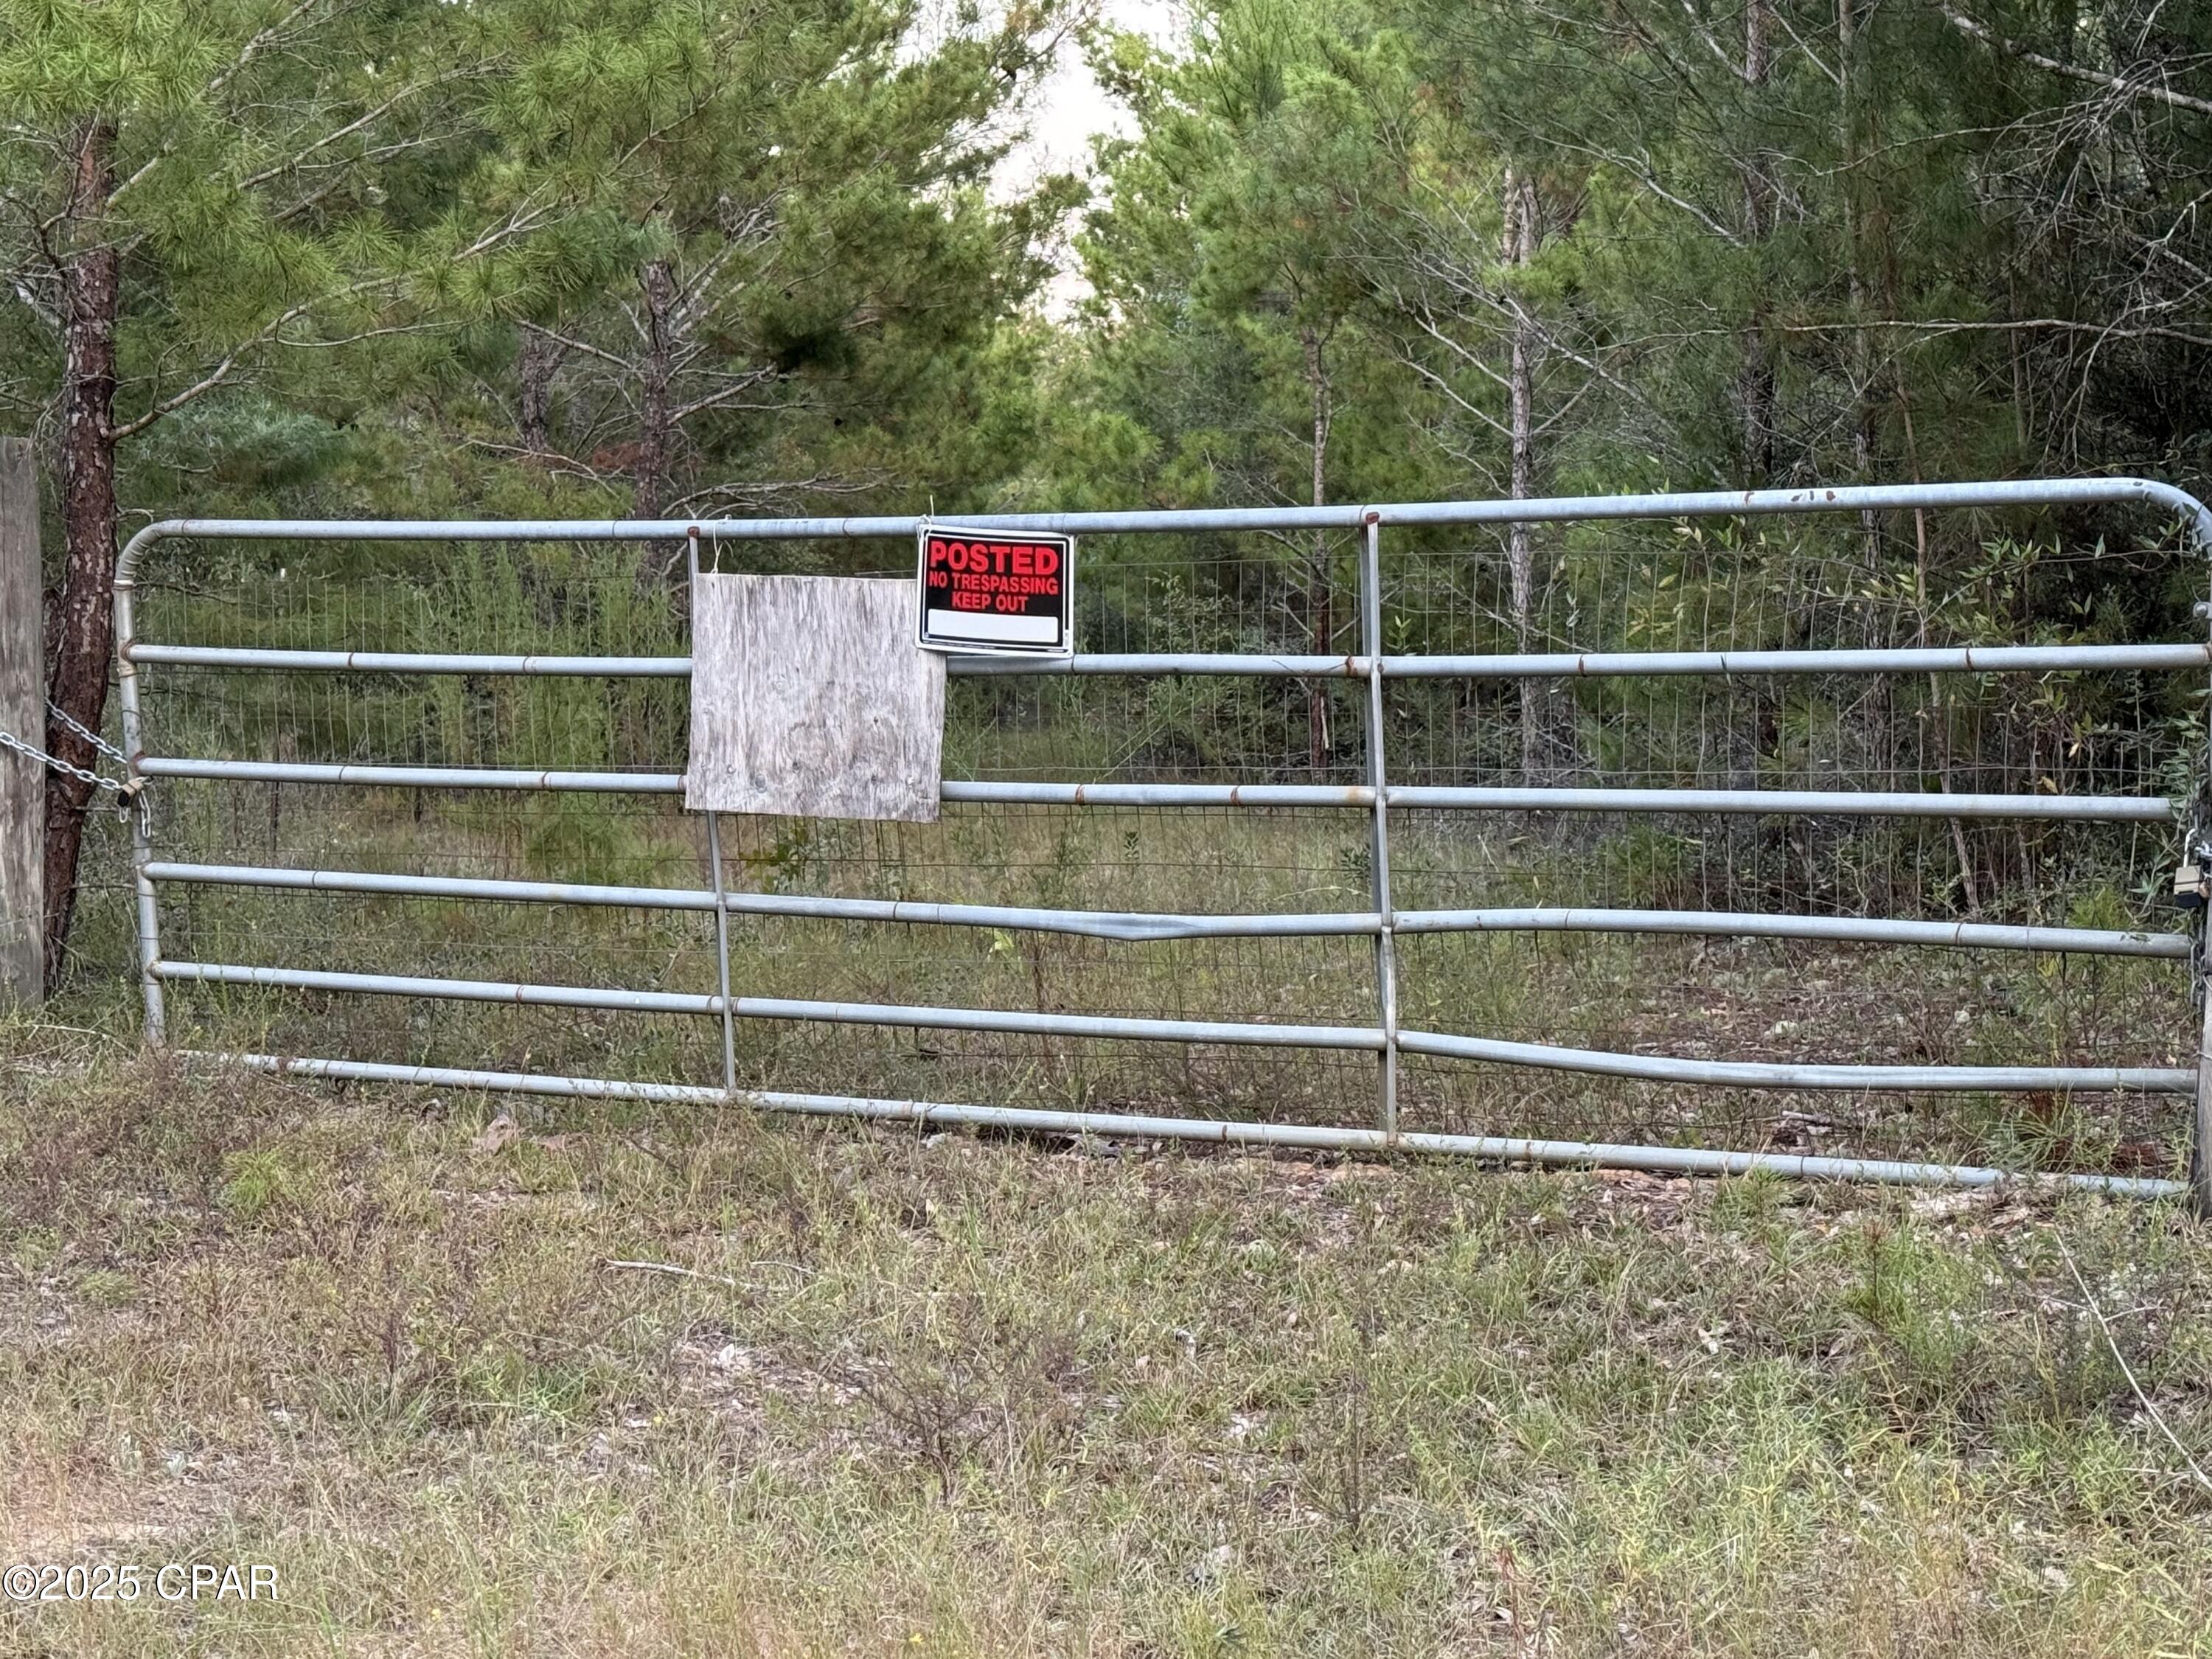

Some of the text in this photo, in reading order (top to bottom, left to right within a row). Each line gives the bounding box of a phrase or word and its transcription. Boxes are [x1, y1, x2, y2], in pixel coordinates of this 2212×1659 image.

[930, 540, 1059, 575] POSTED
[929, 571, 1059, 595] NO TRESPASSING
[952, 591, 1029, 613] KEEP OUT
